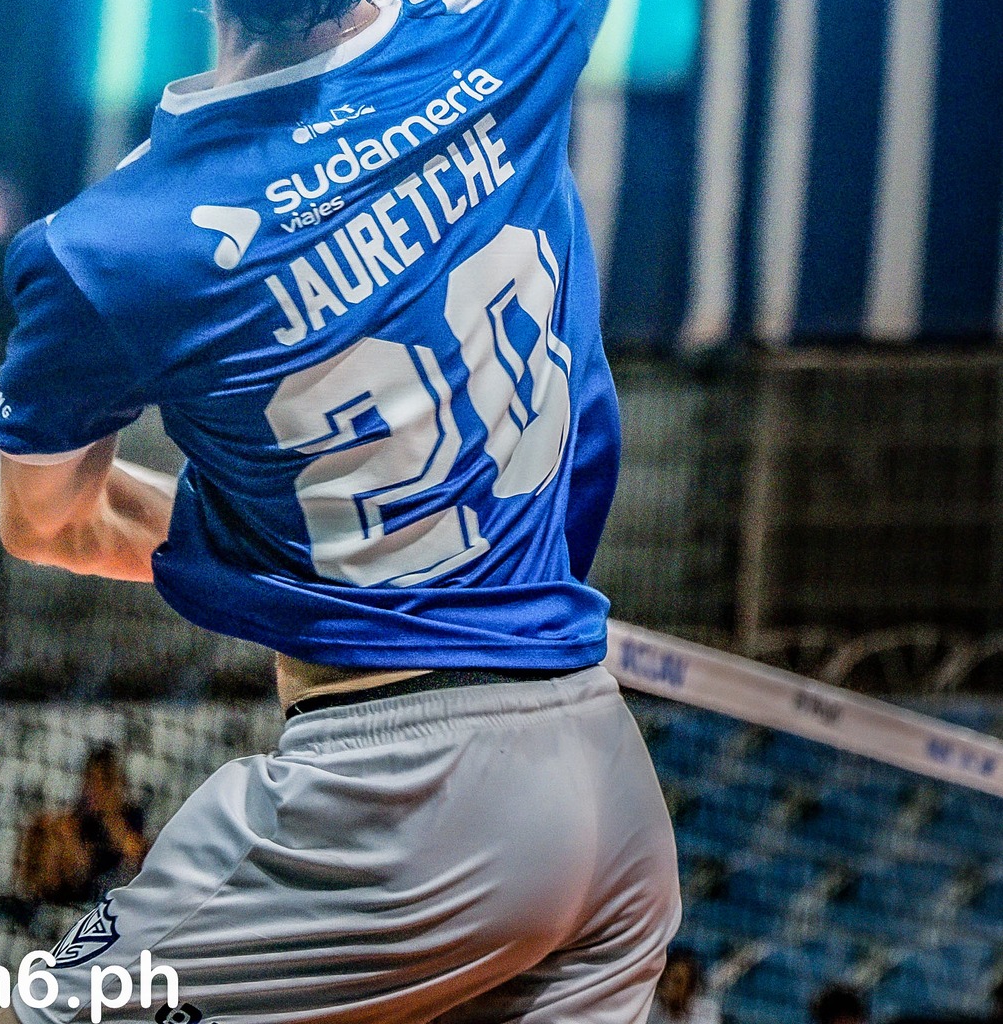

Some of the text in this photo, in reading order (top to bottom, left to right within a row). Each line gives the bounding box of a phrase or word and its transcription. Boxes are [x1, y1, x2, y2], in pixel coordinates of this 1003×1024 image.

[263, 112, 516, 347] JAURETCHE
[264, 65, 503, 215] sudameria
[280, 195, 345, 233] viajes
[264, 224, 571, 588] 20
